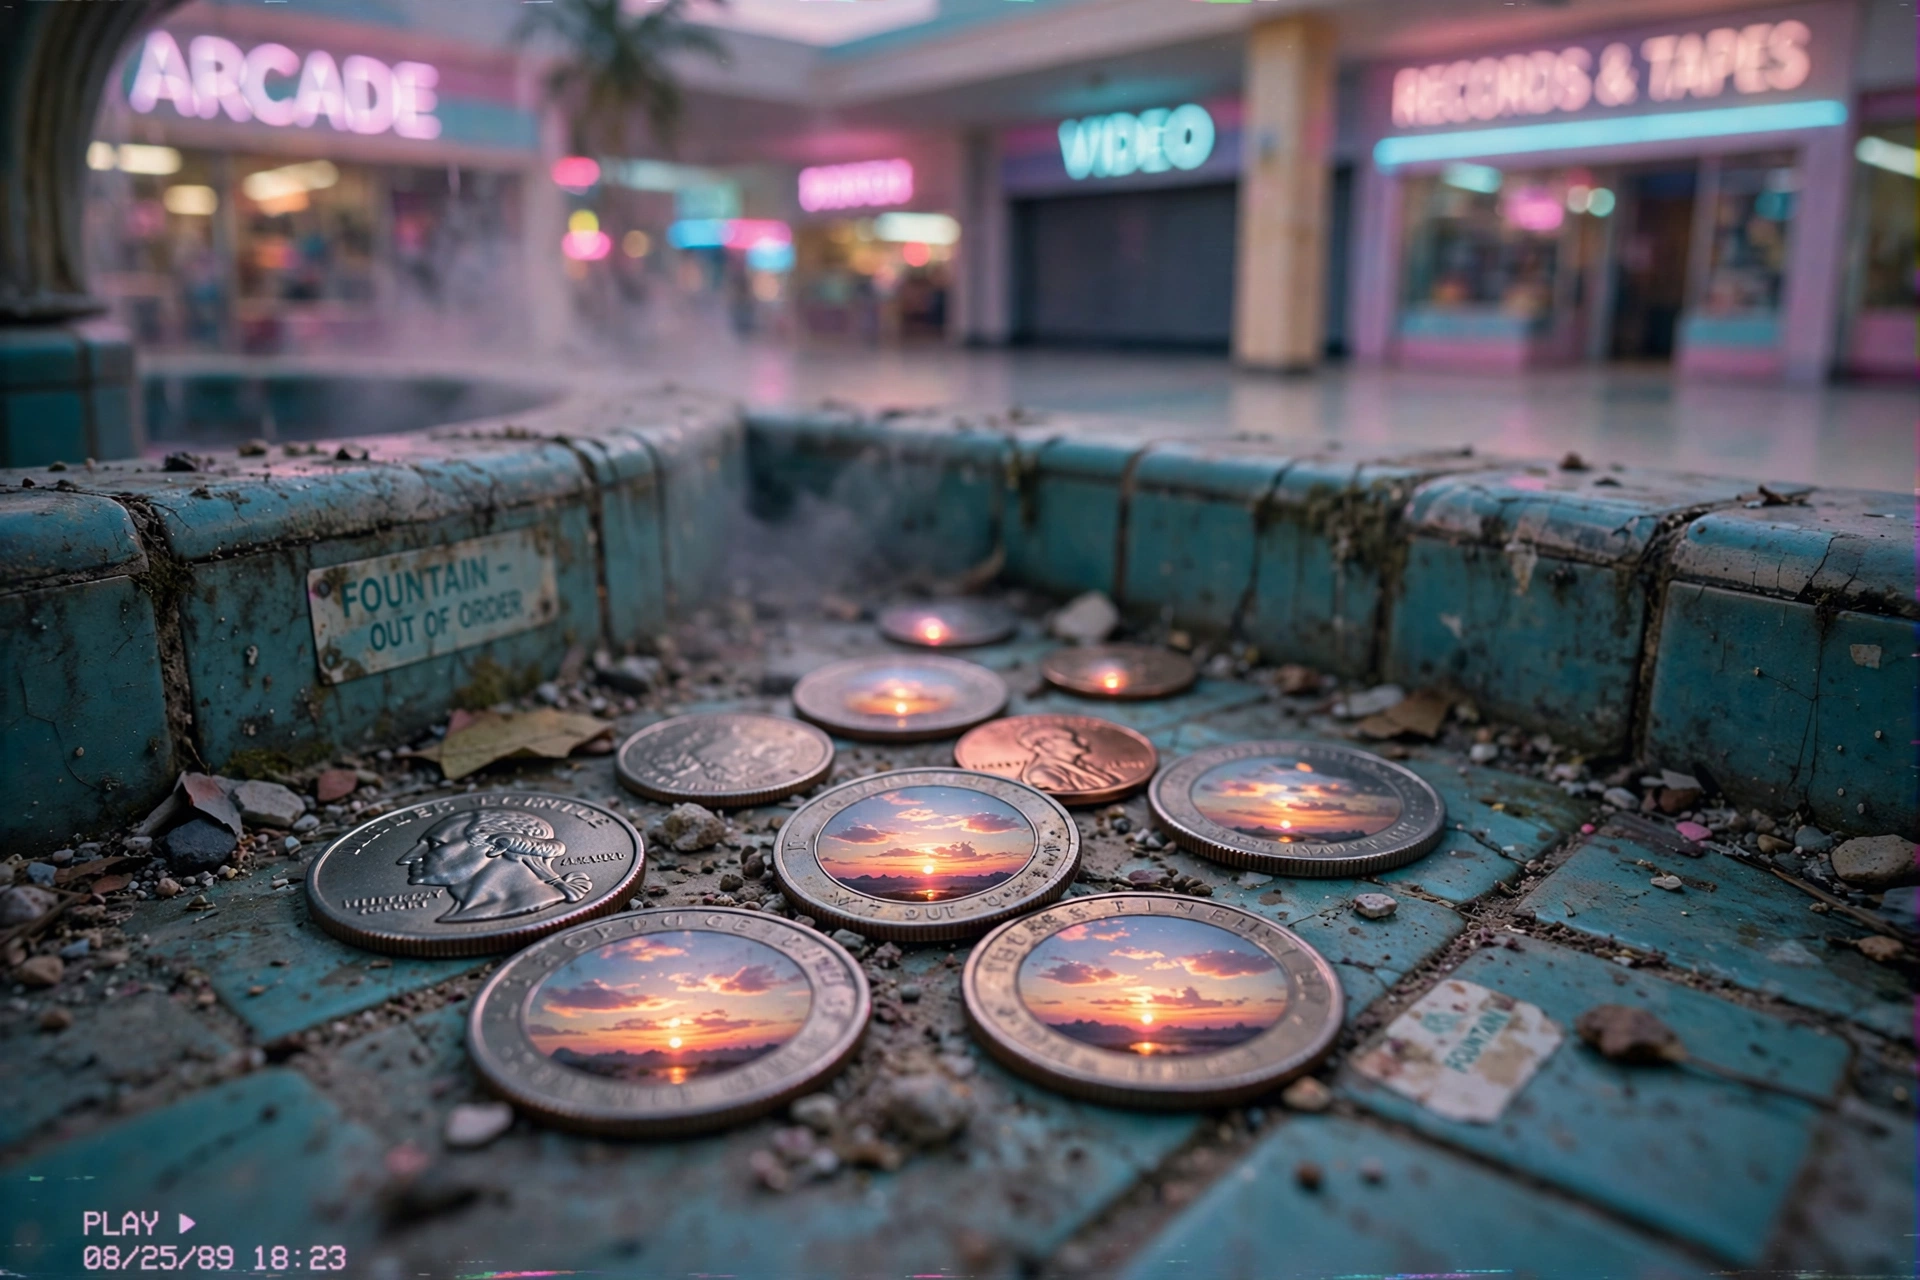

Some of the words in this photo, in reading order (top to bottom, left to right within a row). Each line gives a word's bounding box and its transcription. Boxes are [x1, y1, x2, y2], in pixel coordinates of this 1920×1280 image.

[129, 30, 441, 140] ARCADE
[1594, 42, 1640, 107] &
[1640, 19, 1812, 102] TAPES
[1057, 103, 1215, 181] VIDEO
[339, 555, 489, 618] FOUNTAIN
[370, 614, 416, 652] OUT
[423, 606, 450, 639] OF
[458, 589, 524, 630] ORDER
